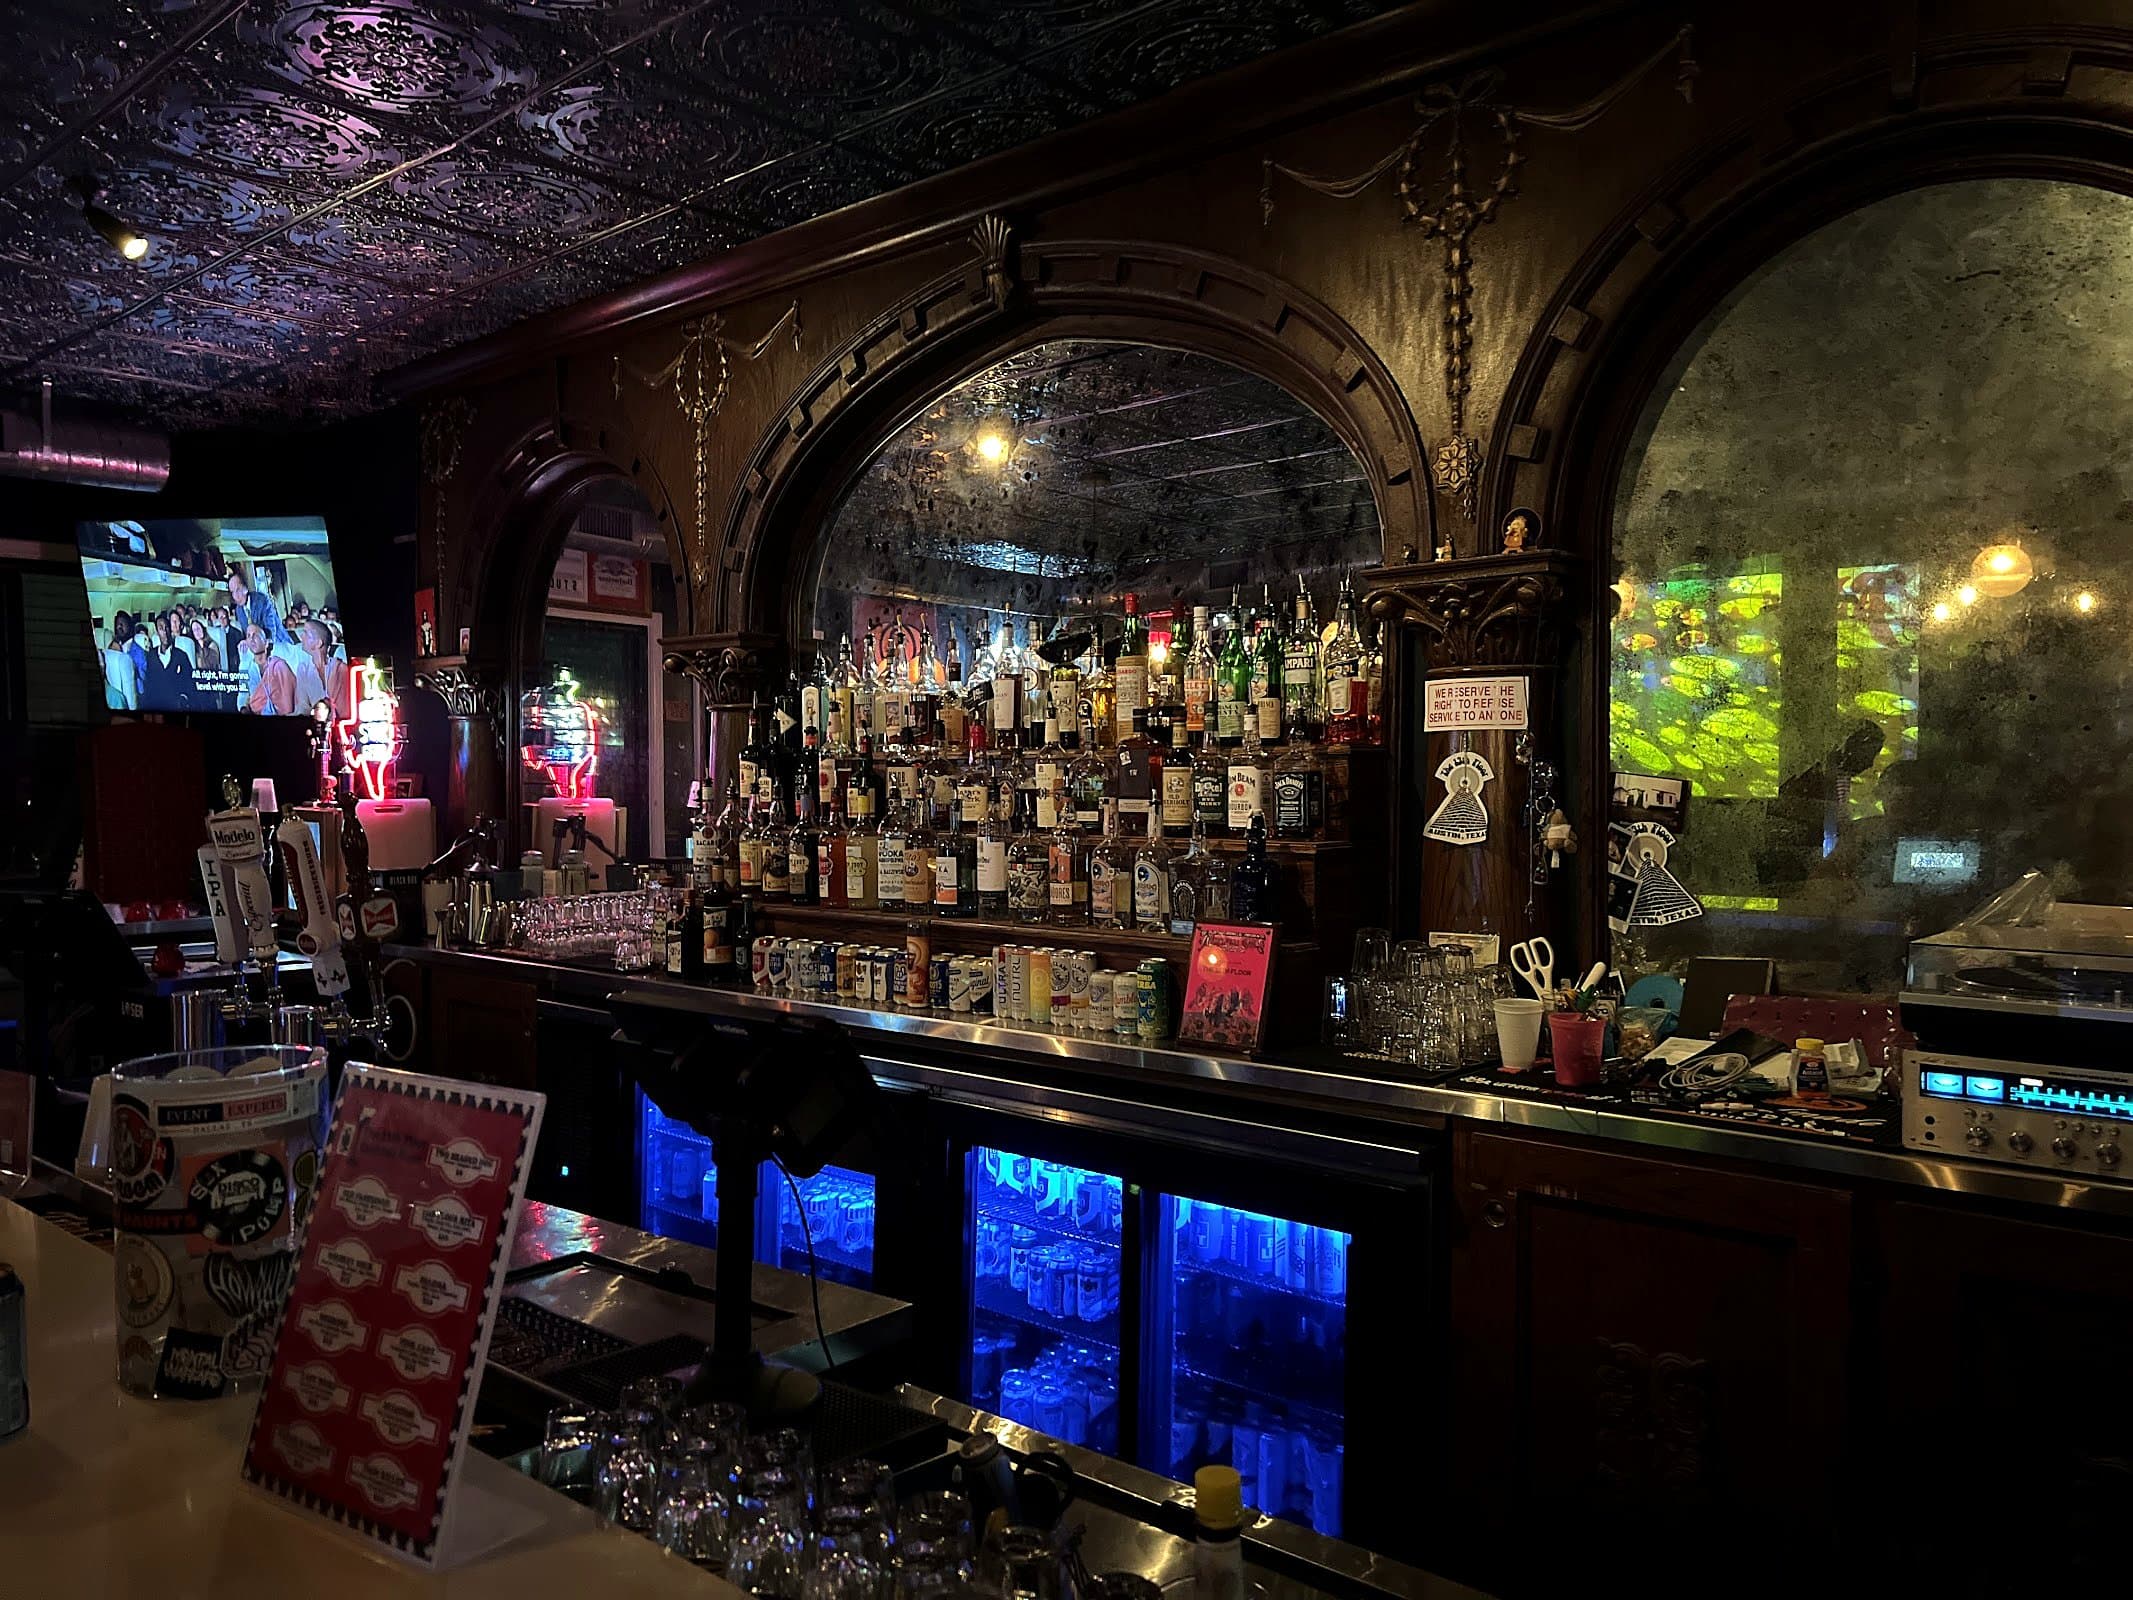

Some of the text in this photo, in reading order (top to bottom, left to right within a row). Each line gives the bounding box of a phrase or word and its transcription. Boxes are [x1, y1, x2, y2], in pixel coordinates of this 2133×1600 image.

[191, 670, 249, 682] All right, I'm gonna
[195, 681, 249, 693] level with you all.
[1434, 685, 1515, 699] WE RESERVE HE
[1434, 698, 1515, 711] RIGH TO REFSE
[1429, 709, 1523, 723] SERVICE TO ANONE
[1440, 763, 1454, 777] The
[1471, 758, 1489, 777] Floor
[213, 828, 256, 844] Modelo
[1428, 827, 1465, 840] AUSTIN,
[1651, 823, 1675, 844] Floor
[205, 860, 227, 917] IPA
[1663, 908, 1701, 923] TEXAS
[997, 964, 1007, 1004] ULTRA
[165, 1106, 211, 1122] EVENT
